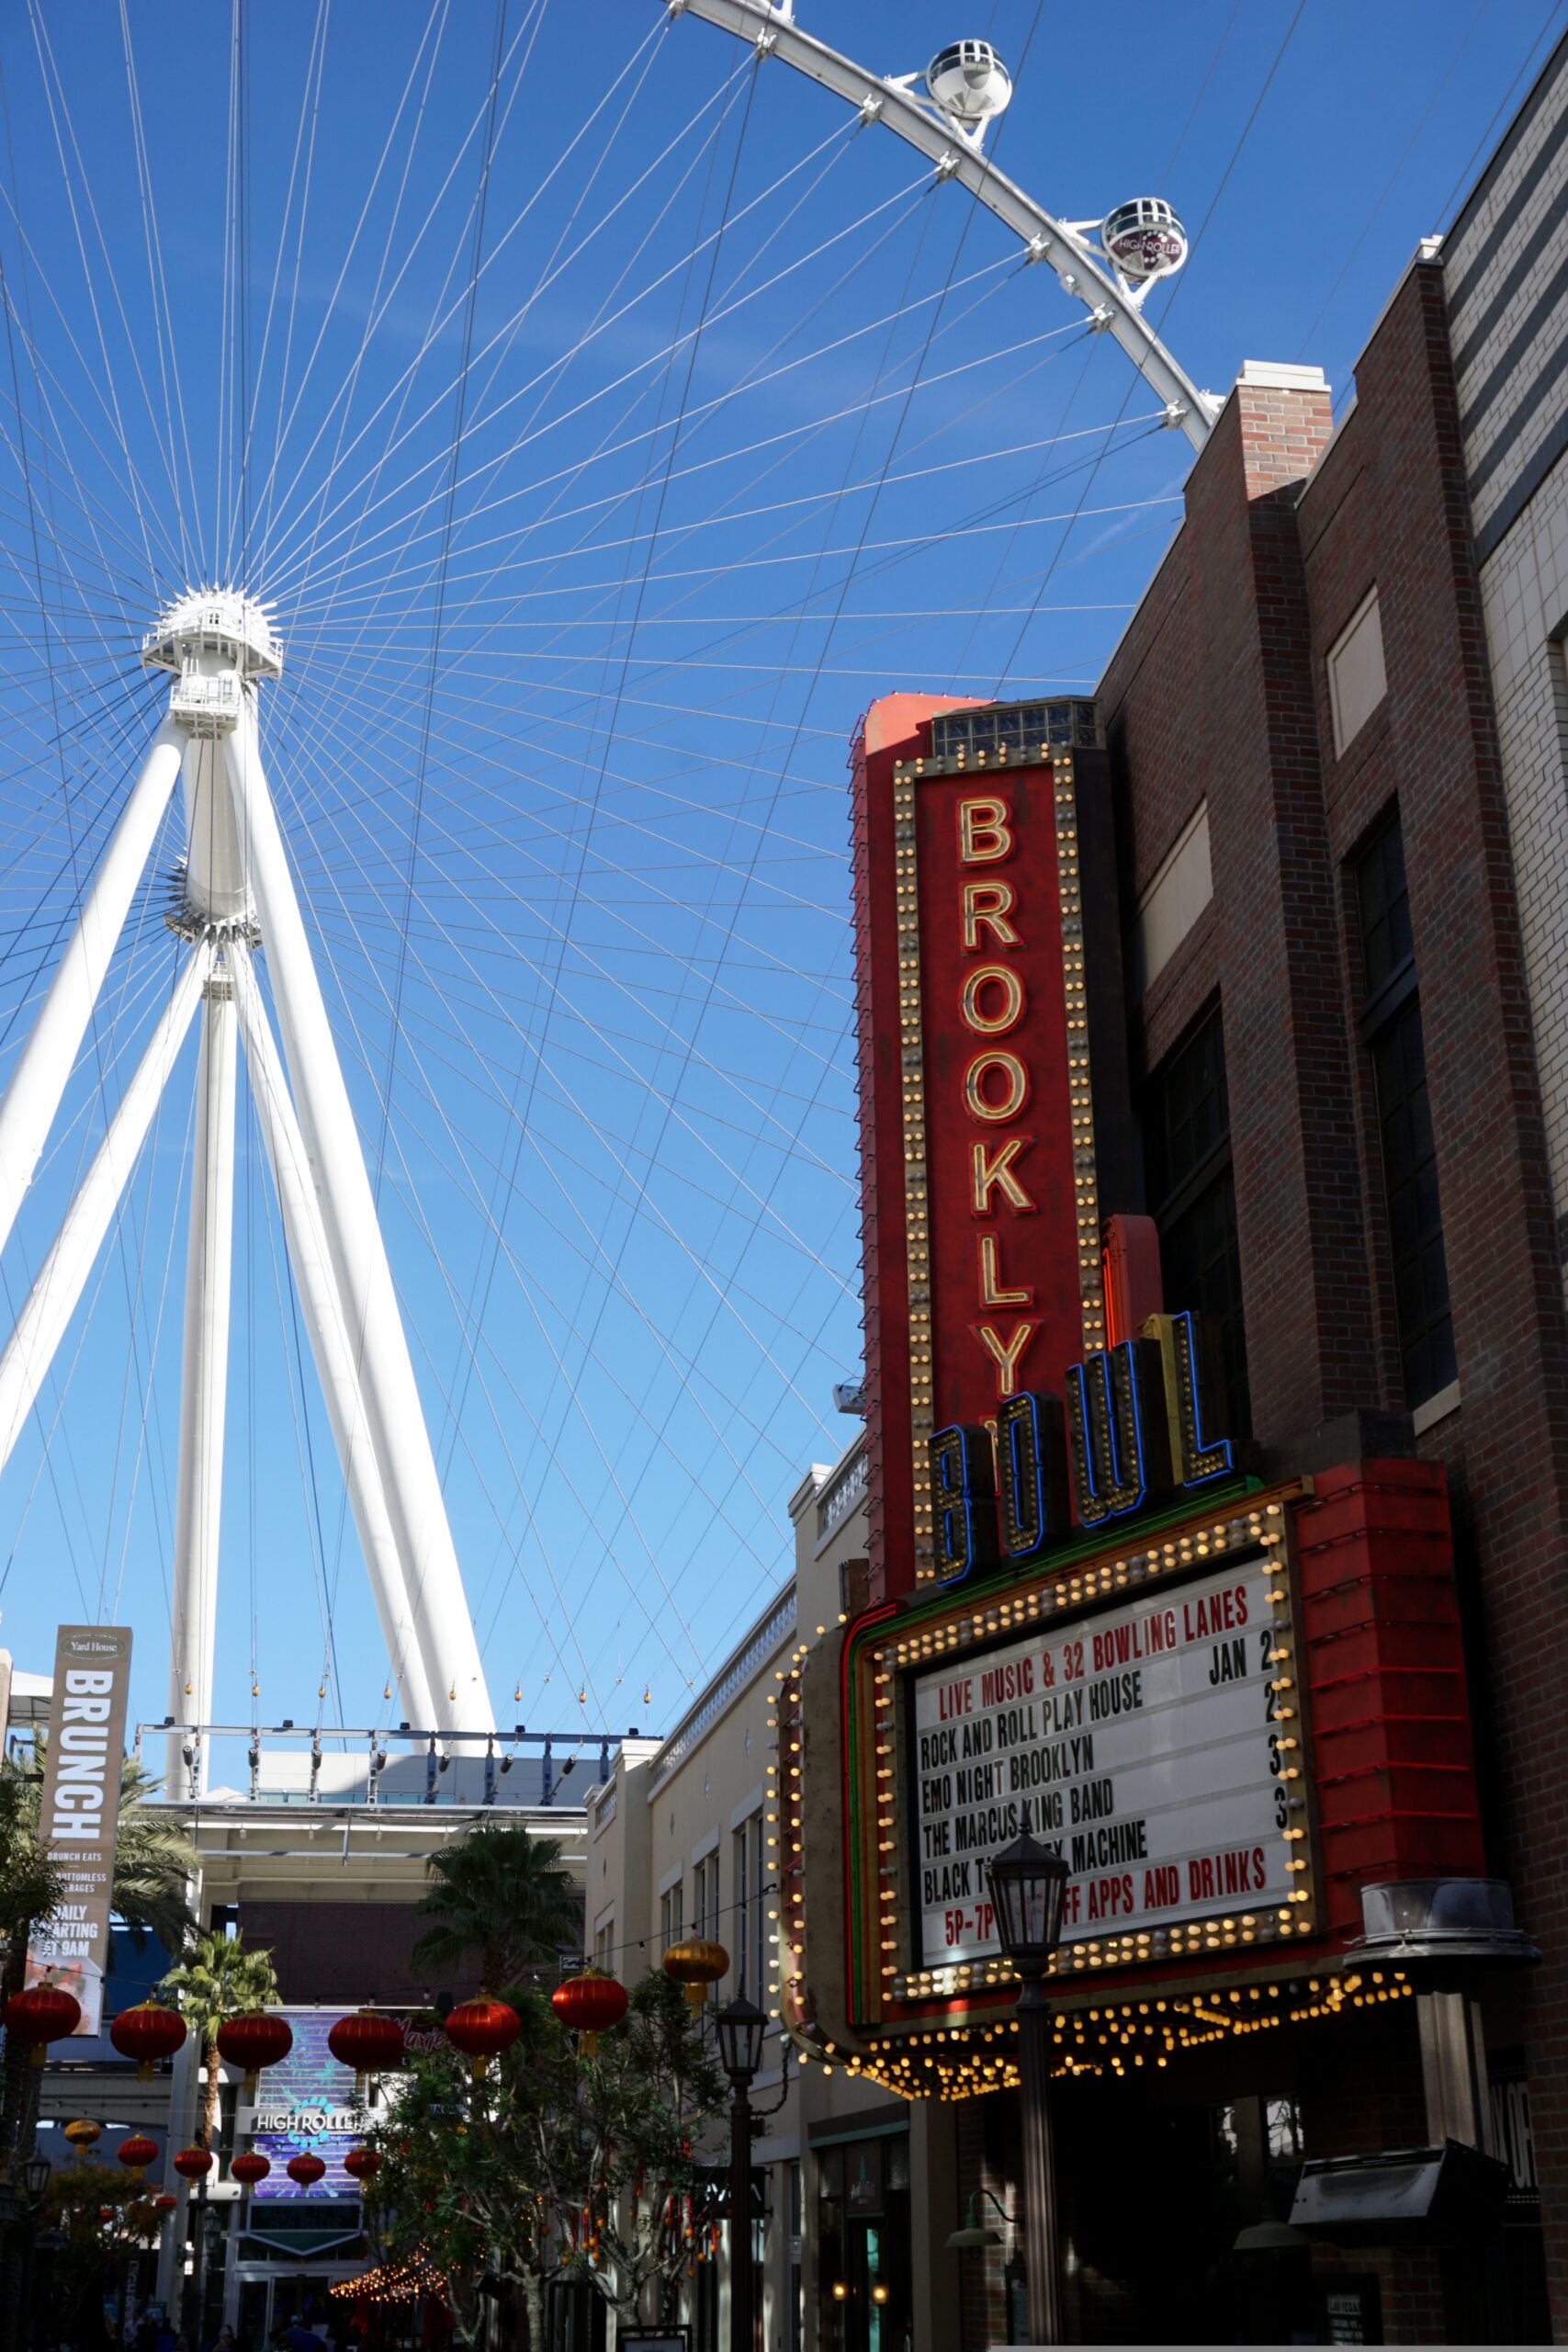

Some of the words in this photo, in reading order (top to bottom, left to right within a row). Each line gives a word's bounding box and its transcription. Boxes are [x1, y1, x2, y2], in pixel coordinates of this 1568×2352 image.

[1119, 239, 1146, 251] HIGH
[1146, 242, 1180, 254] ROLLER
[928, 1311, 1235, 1588] BOWL
[71, 1642, 90, 1651] Yard
[92, 1642, 118, 1652] House
[939, 1679, 972, 1721] LIVE
[982, 1658, 1033, 1708] MUSIC
[1043, 1652, 1055, 1688] &
[1064, 1641, 1084, 1681] 32
[1093, 1610, 1176, 1671] BOWLING
[1184, 1586, 1247, 1642] LANES
[921, 1728, 957, 1770] ROCK
[963, 1722, 991, 1758] AND
[998, 1701, 1037, 1751] ROLL
[1043, 1689, 1082, 1736] PLAY
[1090, 1670, 1143, 1721] HOUSE
[1208, 1638, 1247, 1685] JAN
[51, 1669, 114, 1838] BRUNCH
[922, 1770, 951, 1814] EMO
[957, 1758, 1004, 1804] NIGHT
[1011, 1734, 1094, 1792] BROOKLYN
[923, 1815, 950, 1860] THE
[954, 1802, 1017, 1852] MARCUS
[1021, 1794, 1063, 1835] KING
[1070, 1778, 1113, 1825] BAND
[47, 1852, 80, 1861] BRUNCH
[83, 1852, 102, 1861] EATS
[56, 1872, 107, 1882] BOTTOMLESS
[924, 1862, 970, 1905] BLACK
[1072, 1819, 1147, 1873] MACHINE
[1089, 1872, 1134, 1919] APPS
[1145, 1864, 1179, 1910] AND
[1189, 1847, 1266, 1901] DRINKS
[52, 1905, 87, 1920] DAILY
[62, 1940, 89, 1956] 9AM
[257, 2114, 299, 2131] HIGH
